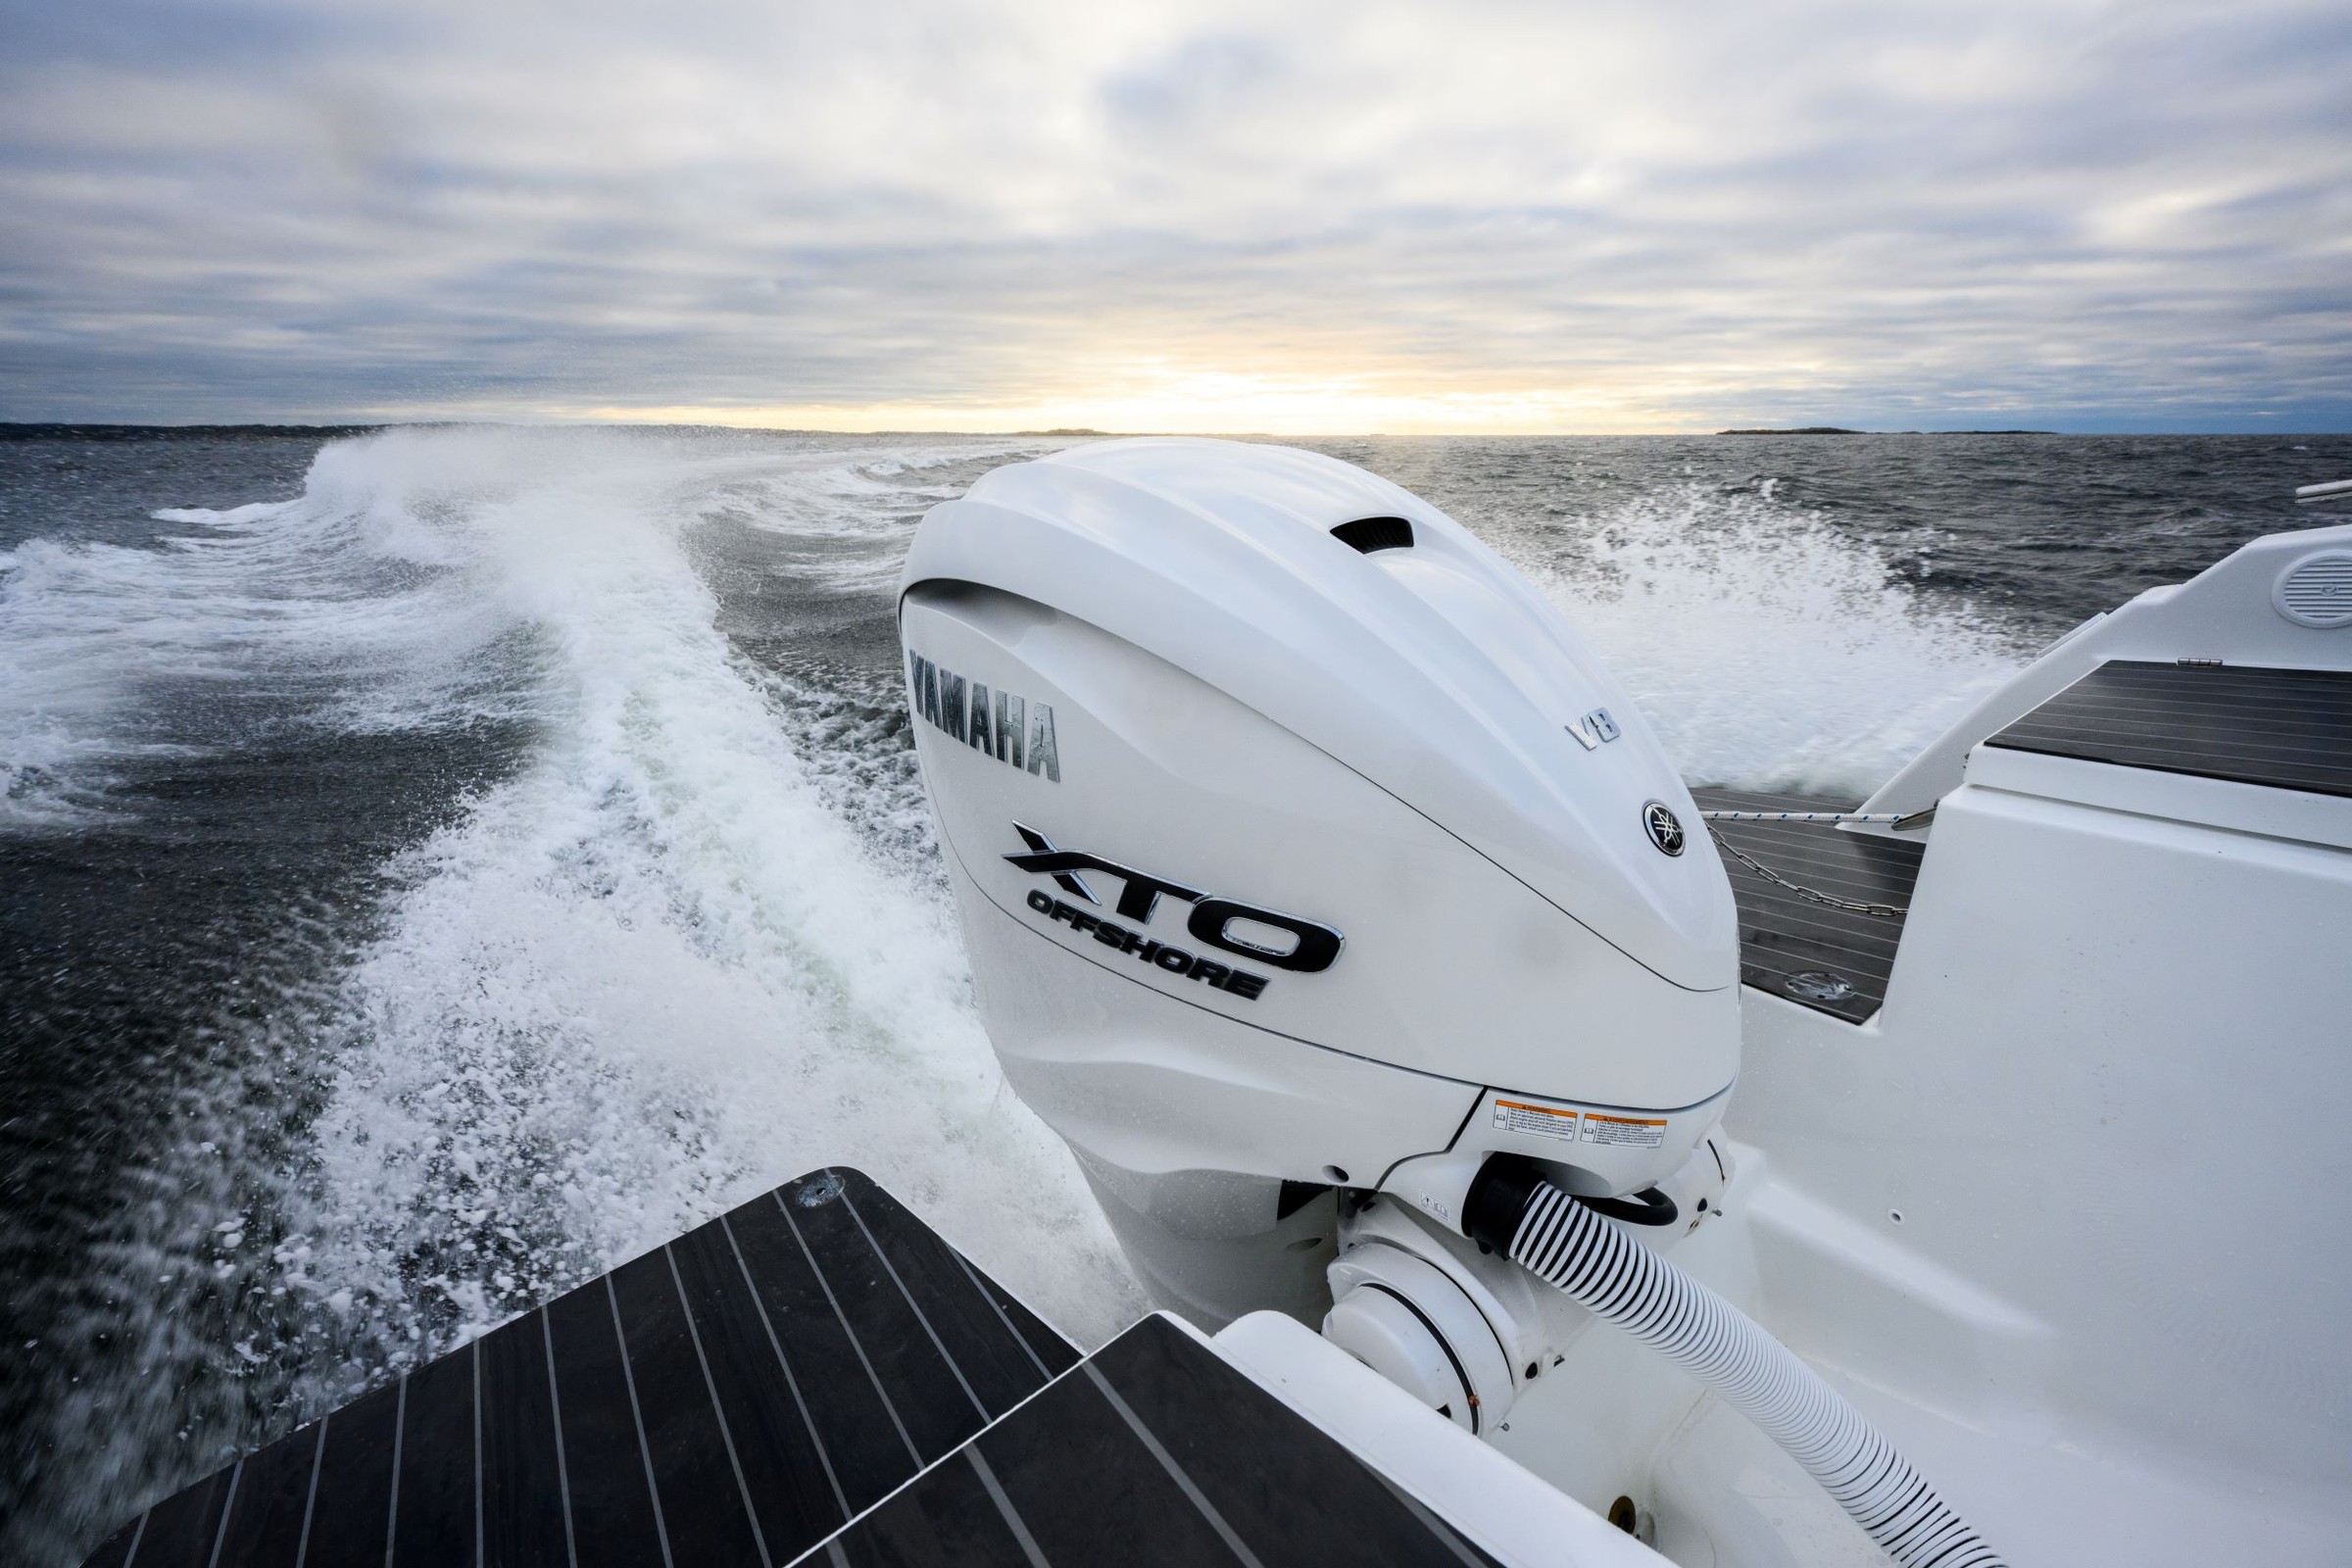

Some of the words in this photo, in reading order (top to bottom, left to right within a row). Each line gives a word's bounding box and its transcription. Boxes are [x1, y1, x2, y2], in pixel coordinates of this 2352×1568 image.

[908, 648, 1060, 783] YAMAHA
[1564, 707, 1621, 751] V8
[1001, 818, 1347, 973] XTO
[1027, 888, 1271, 1001] OFFSHORE
